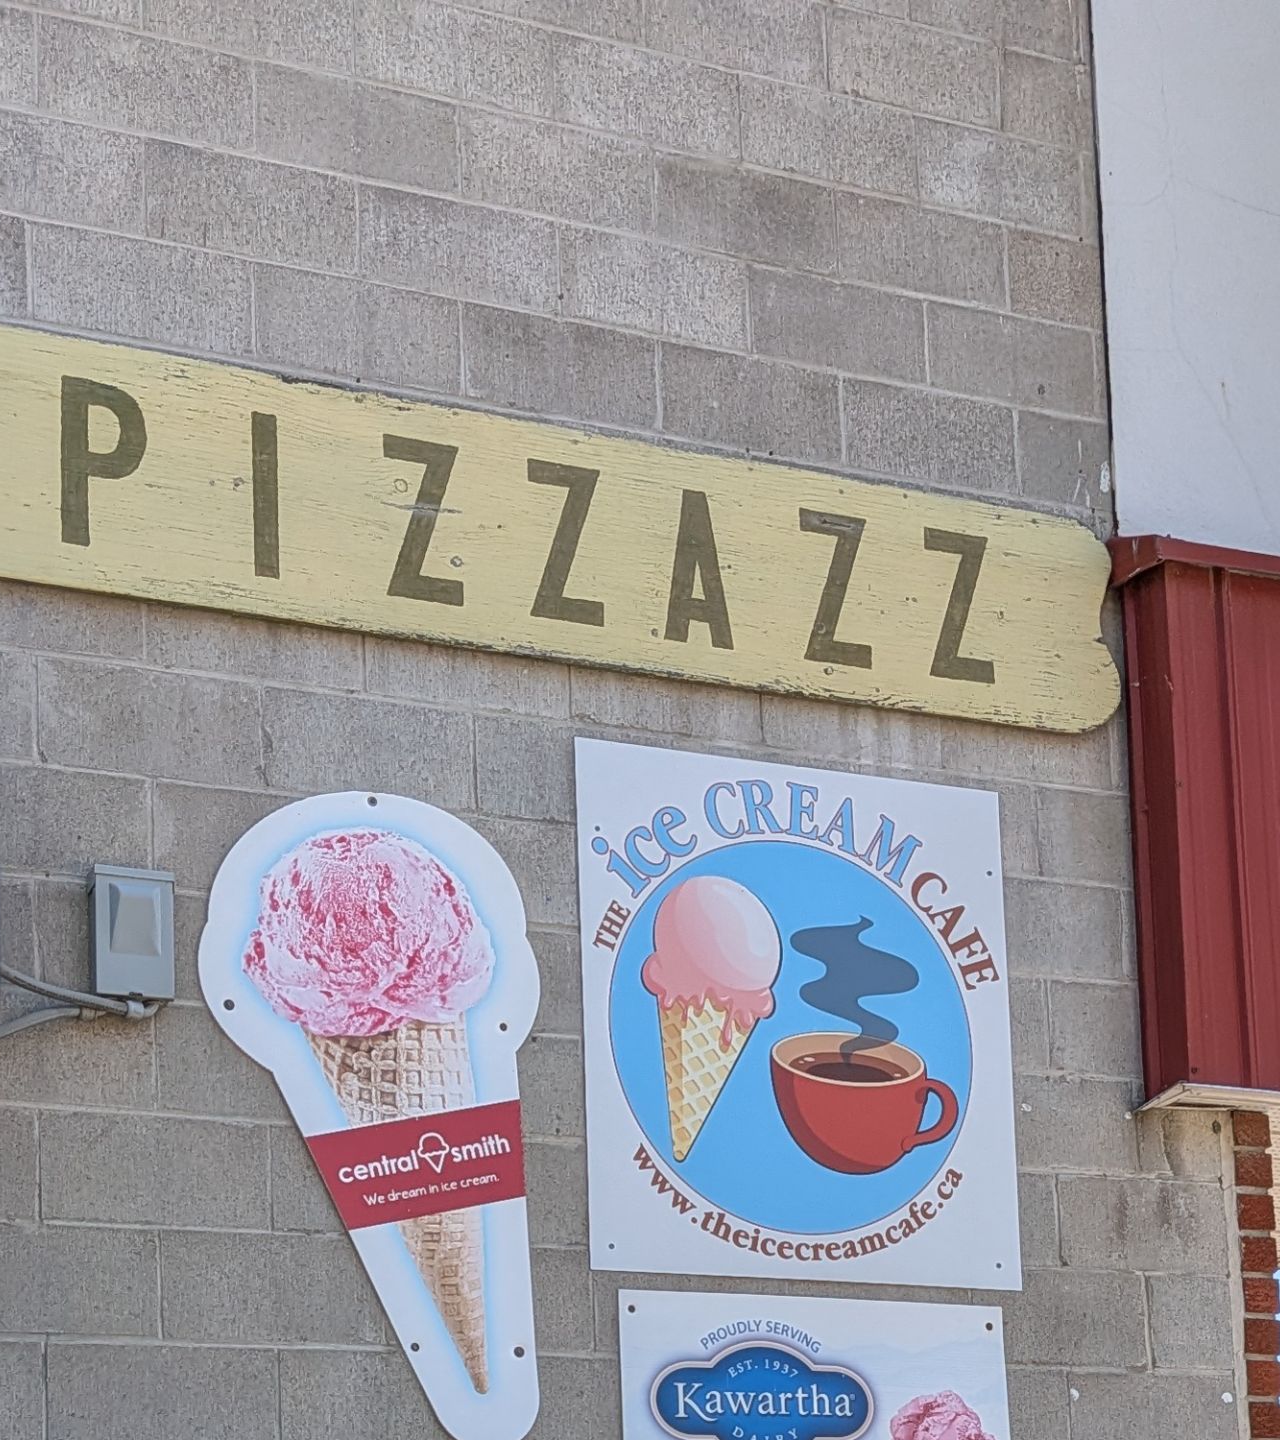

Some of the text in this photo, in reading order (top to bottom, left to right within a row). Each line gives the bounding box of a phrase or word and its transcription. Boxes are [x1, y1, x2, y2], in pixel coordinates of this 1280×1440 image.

[59, 374, 997, 685] PIZZAZZ
[593, 899, 632, 953] THE
[703, 779, 923, 889] CREAM
[910, 871, 1001, 992] CAFE
[337, 1133, 511, 1184] central smith
[363, 1173, 500, 1206] We dream in ice cream.
[632, 1142, 964, 1262] www.theicecreamcafe.ca
[699, 1319, 822, 1354] PROUDLY SERVING
[727, 1358, 799, 1378] EST. 1937
[673, 1381, 854, 1422] Kawartha
